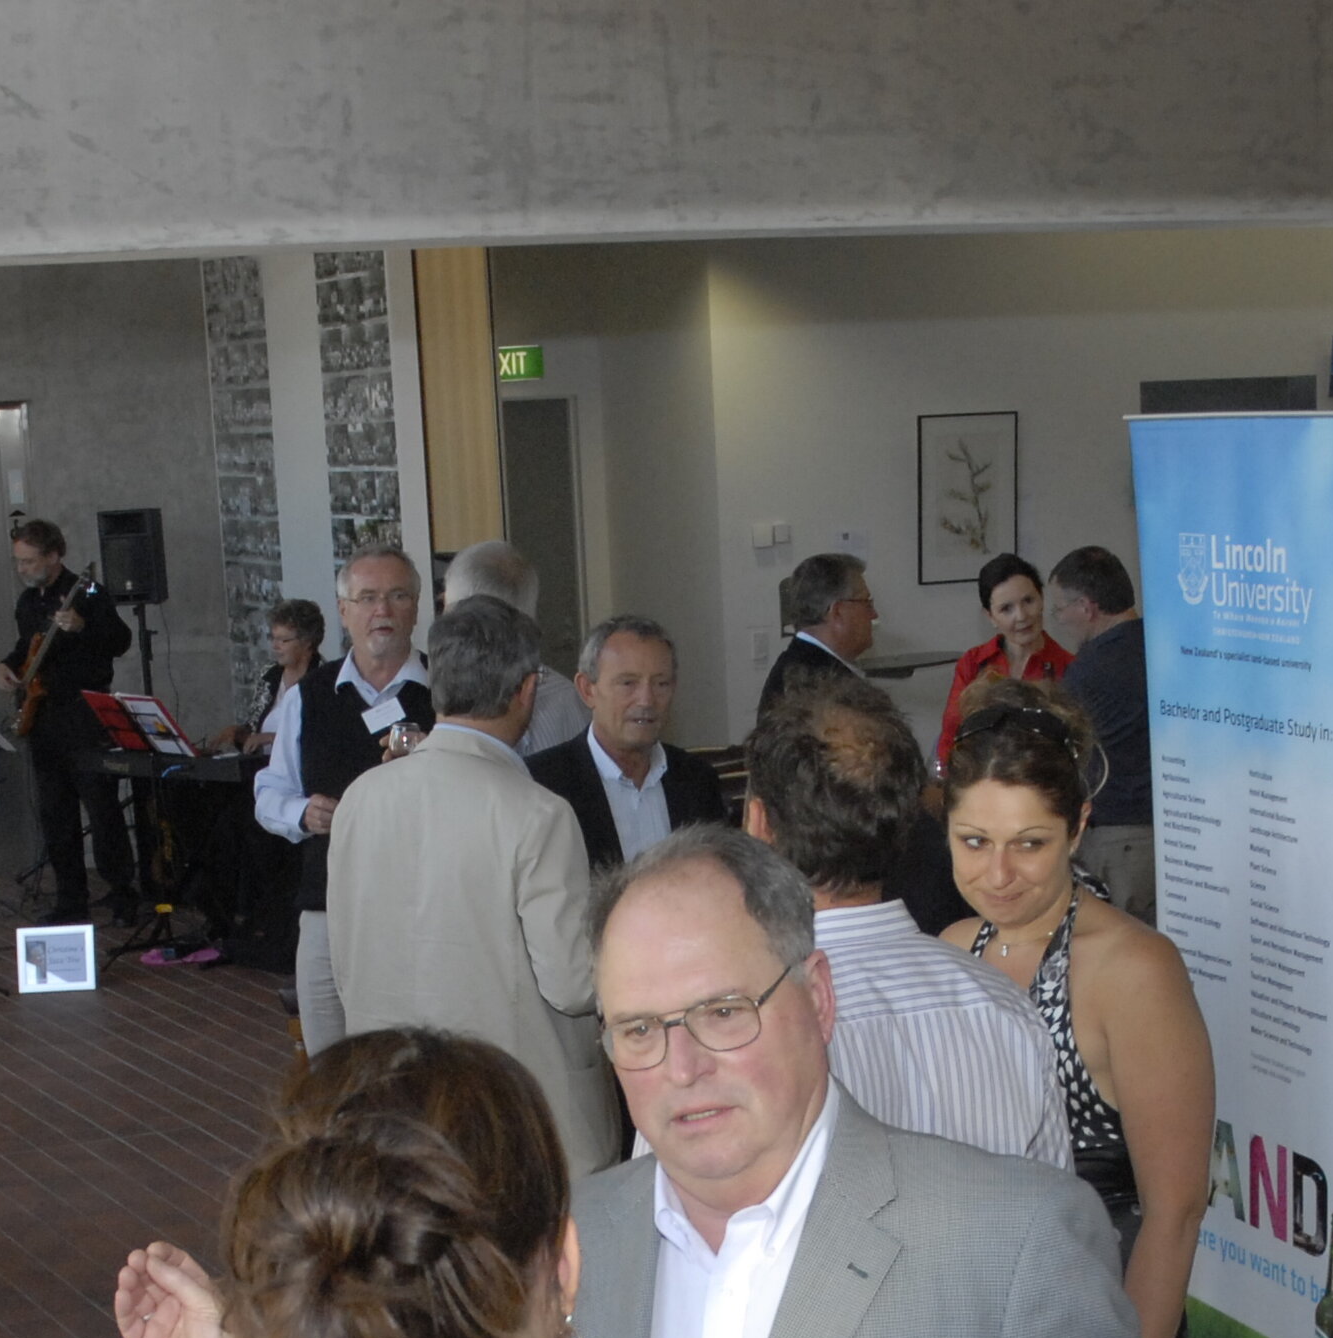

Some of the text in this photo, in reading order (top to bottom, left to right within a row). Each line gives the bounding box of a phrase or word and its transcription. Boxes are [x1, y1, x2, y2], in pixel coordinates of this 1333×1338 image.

[498, 351, 527, 376] XIT
[1210, 534, 1286, 574] Lincoln
[1211, 571, 1313, 625] University
[1159, 699, 1333, 743] Bachelor and Postgraduate Study in:
[1219, 1236, 1246, 1264] you
[1250, 1251, 1288, 1288] want
[1290, 1267, 1306, 1296] to
